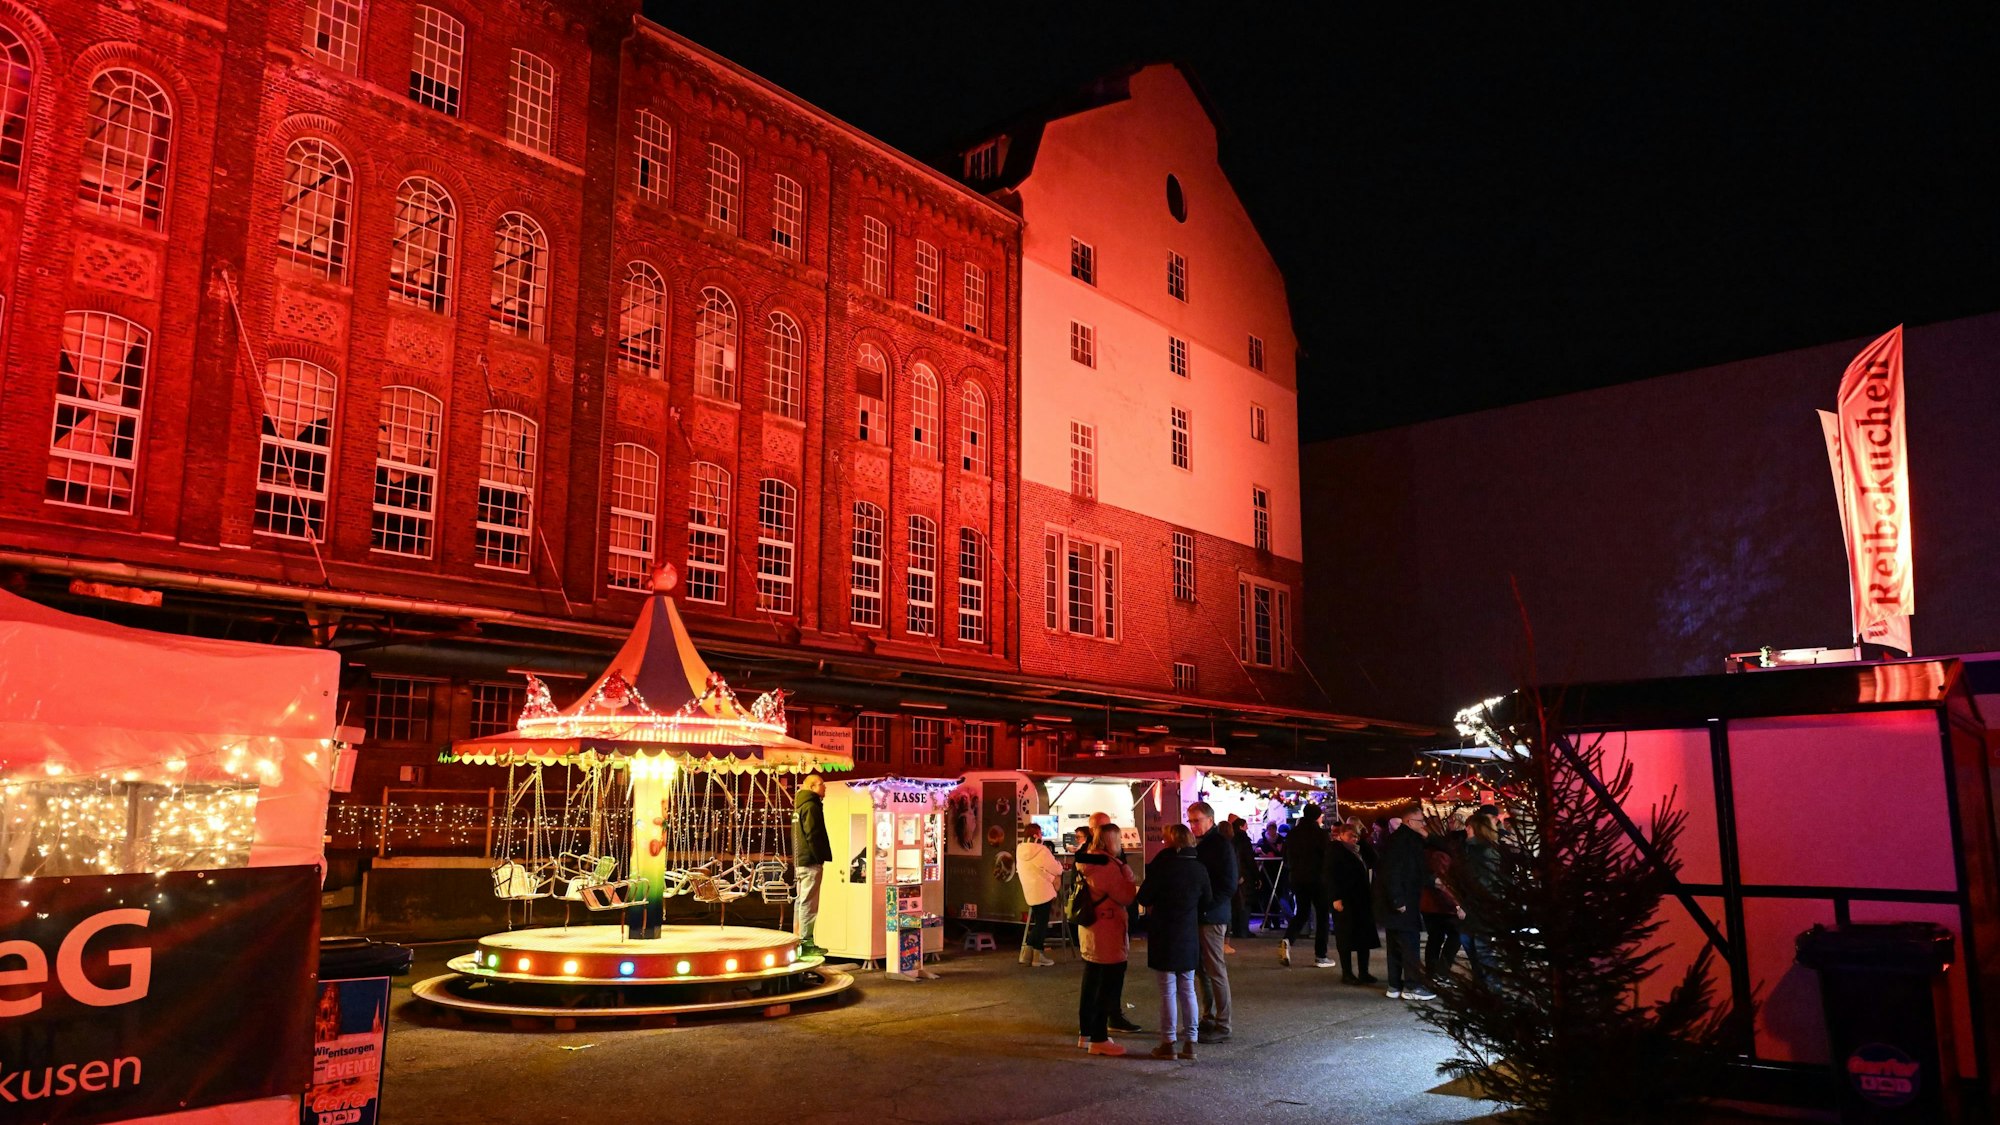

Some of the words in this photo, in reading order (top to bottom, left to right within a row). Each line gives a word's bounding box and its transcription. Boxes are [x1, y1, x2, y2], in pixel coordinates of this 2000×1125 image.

[1856, 357, 1900, 606] Reibekuchen
[893, 792, 927, 803] KASSE
[328, 1043, 375, 1058] entsorgen
[327, 1056, 376, 1079] EVENT!
